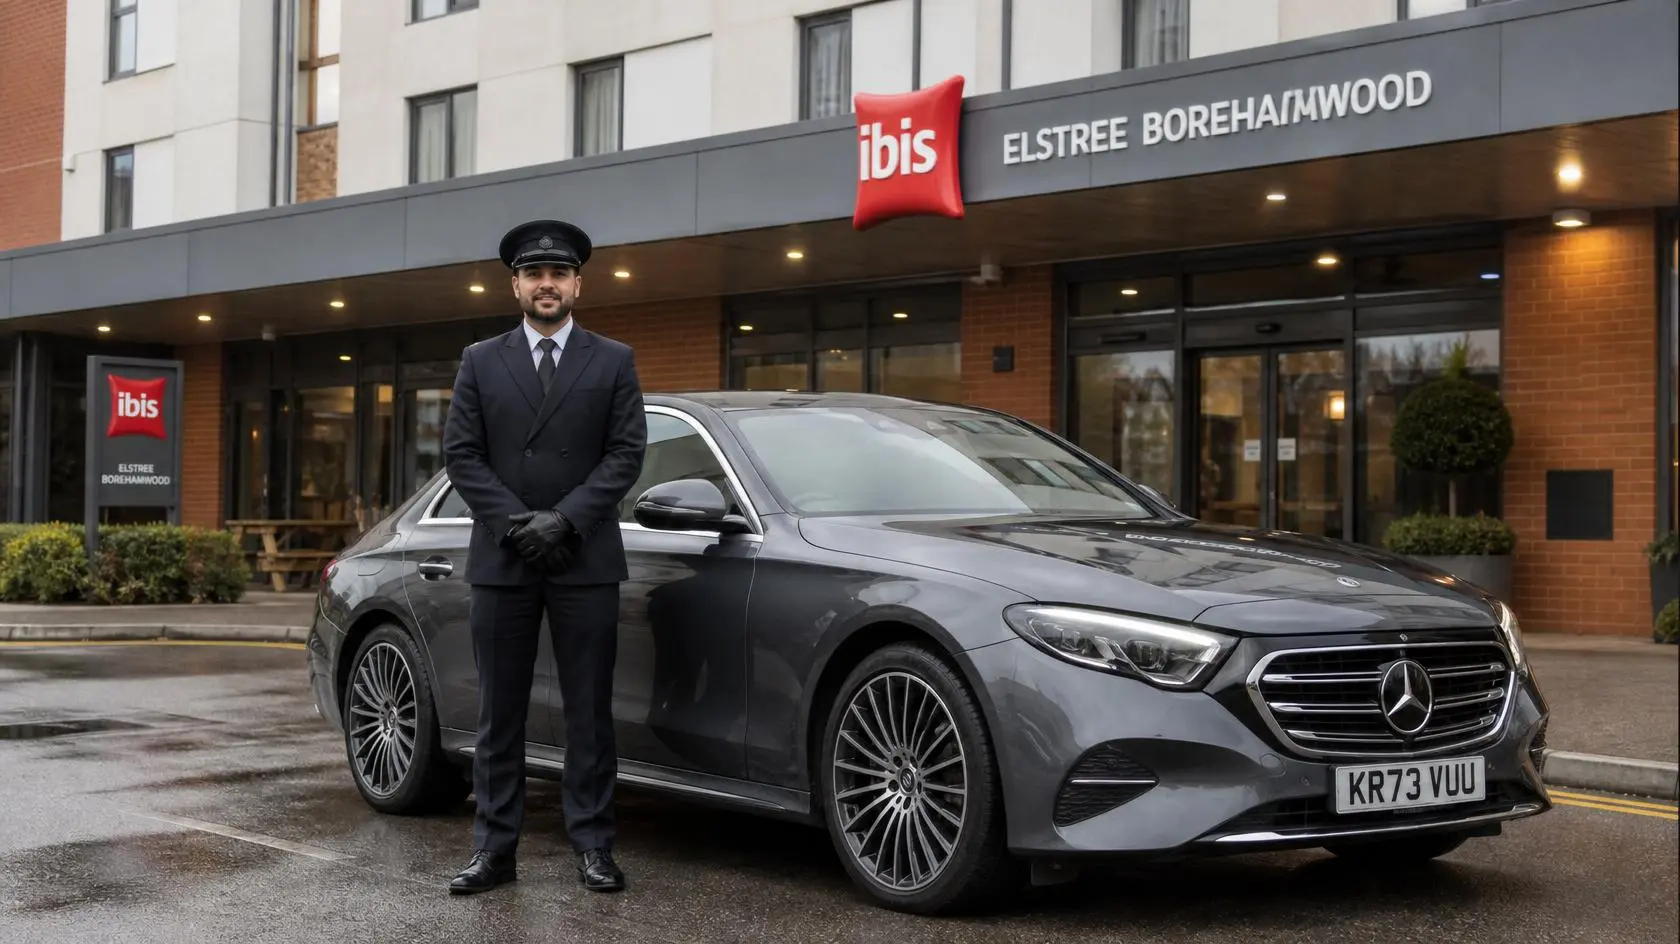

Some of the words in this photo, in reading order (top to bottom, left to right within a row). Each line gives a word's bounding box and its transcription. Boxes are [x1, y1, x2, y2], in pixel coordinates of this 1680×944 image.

[859, 117, 938, 181] ibis
[1003, 116, 1129, 165] ELSTREE
[118, 392, 159, 418] ibis
[118, 463, 155, 473] ELSTREE
[1349, 767, 1421, 805] KR73
[1429, 762, 1475, 798] VUU
